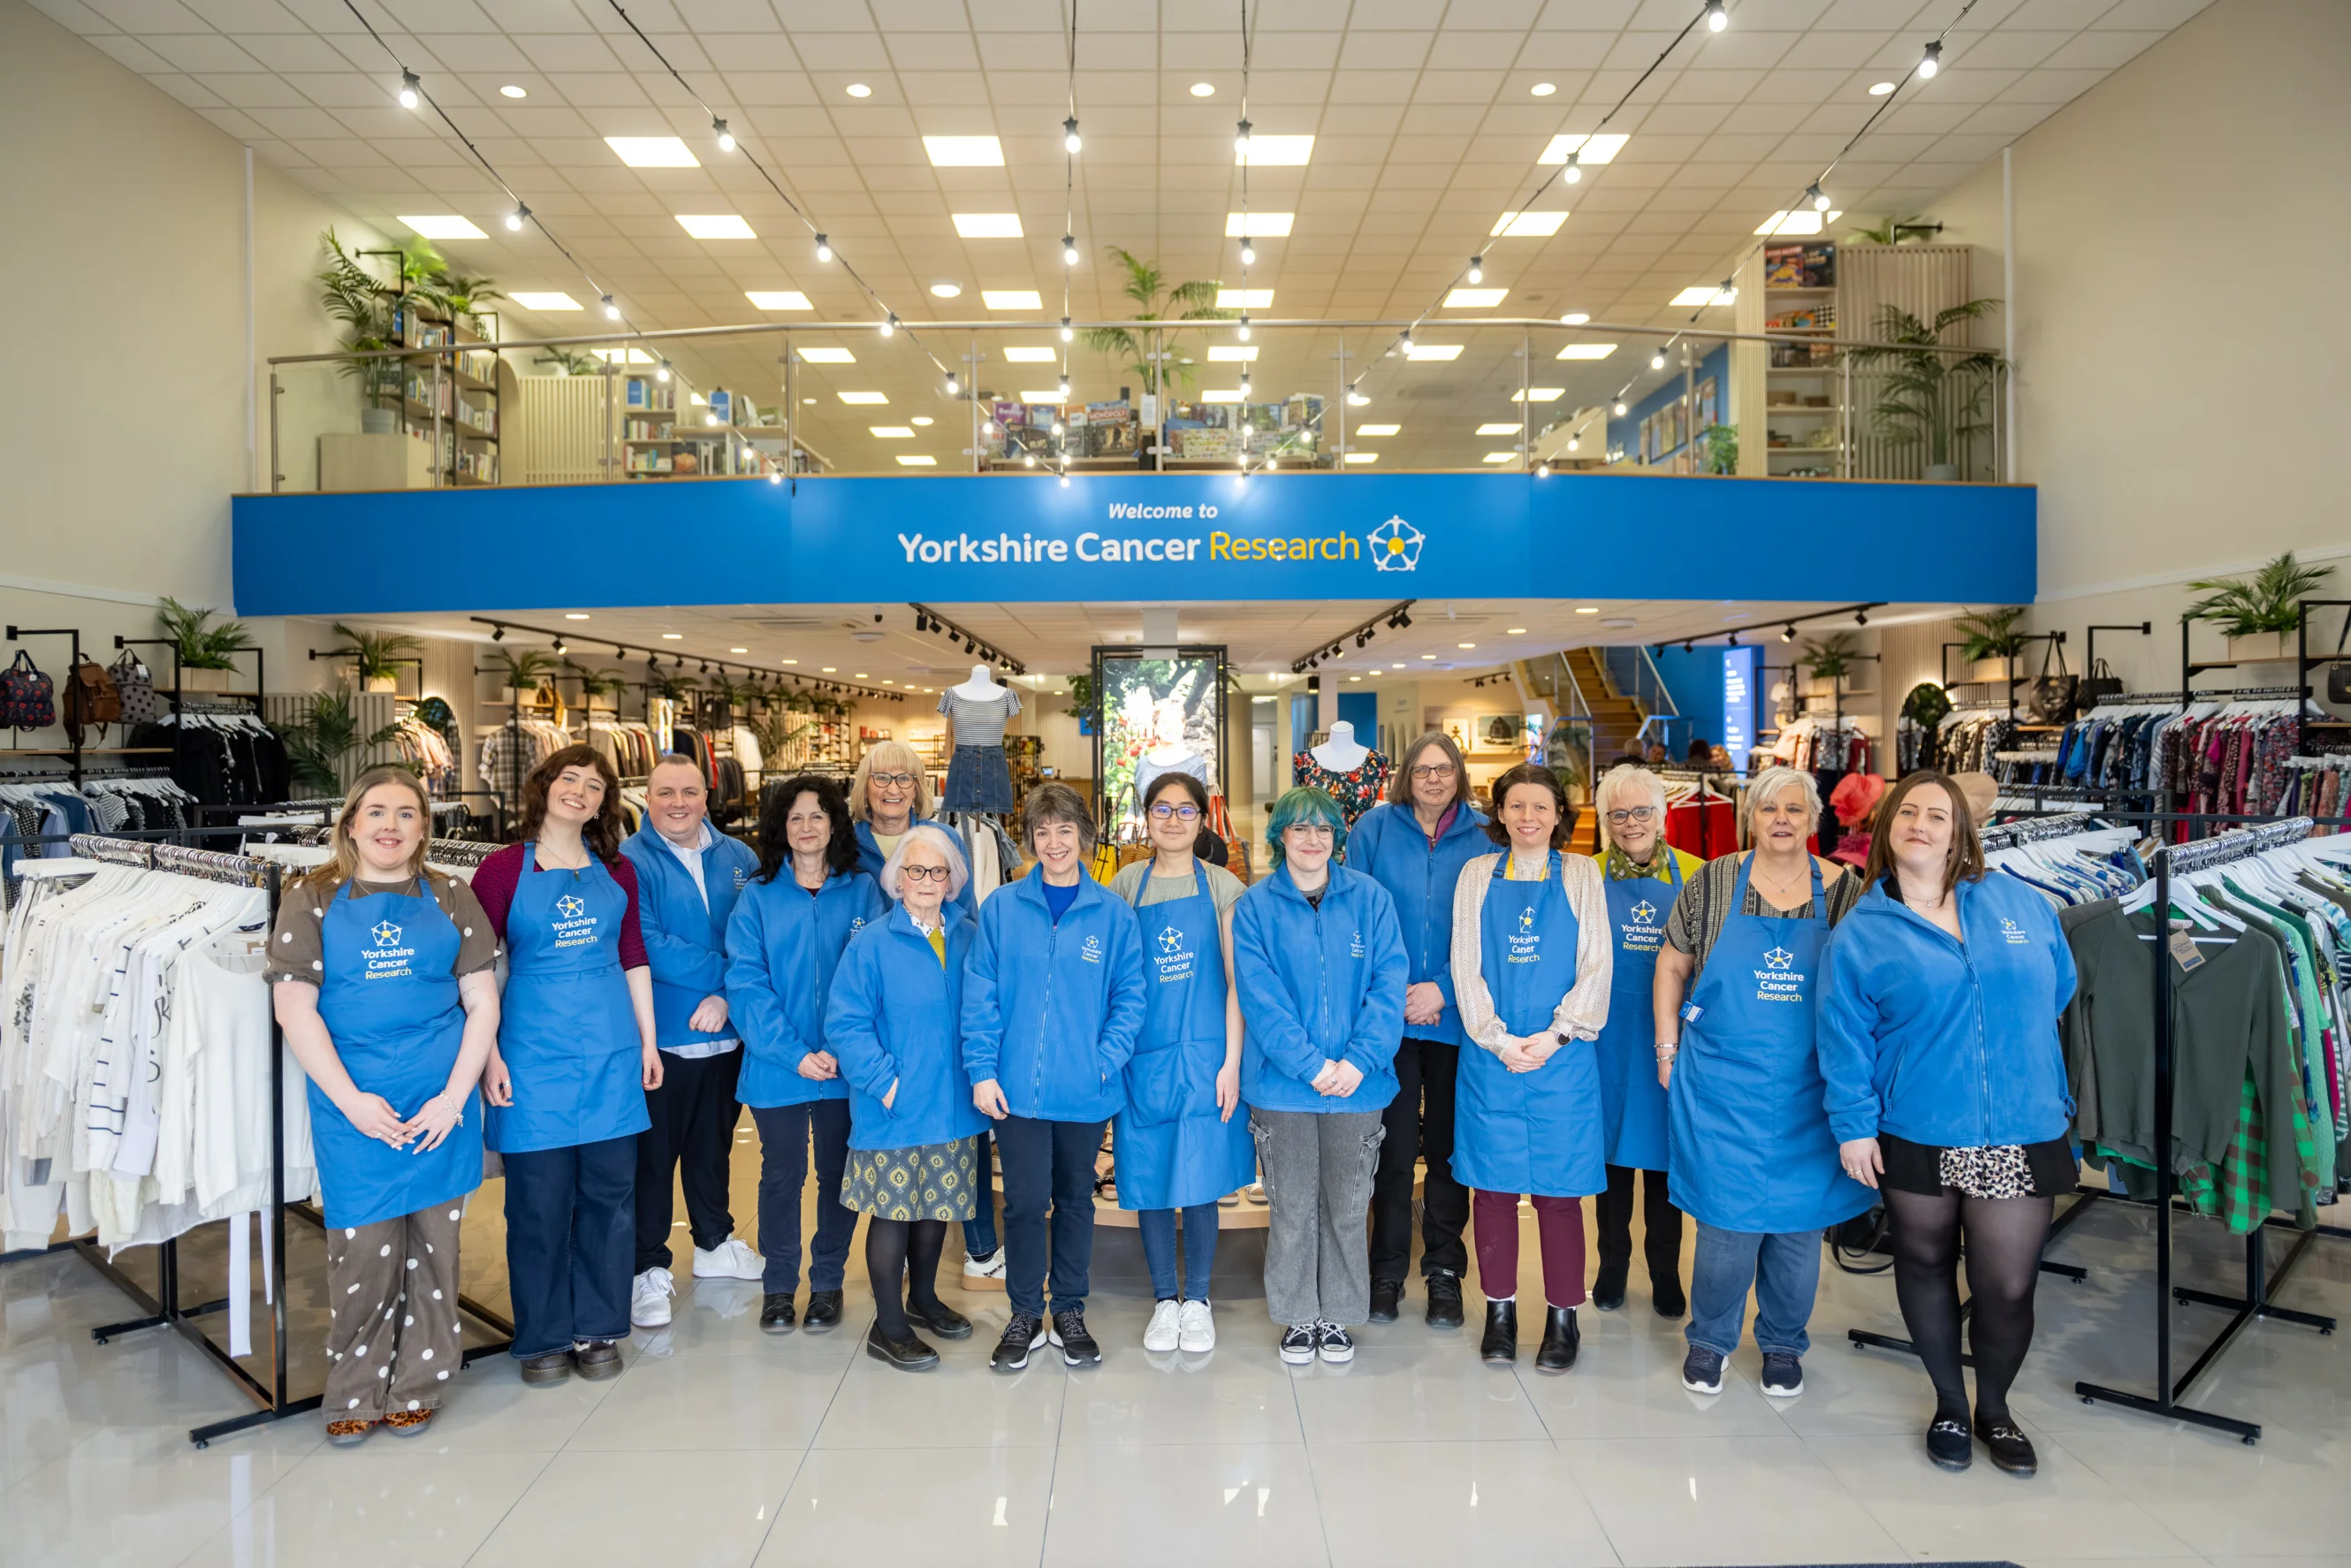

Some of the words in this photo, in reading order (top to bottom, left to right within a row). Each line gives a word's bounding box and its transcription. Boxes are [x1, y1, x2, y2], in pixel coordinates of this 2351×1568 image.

[1108, 503, 1192, 519] Welcome
[1198, 503, 1219, 519] to
[897, 532, 1068, 563] Yorkshire
[1075, 532, 1201, 561] Cancer
[1209, 530, 1360, 560] Research
[552, 917, 597, 931] Yorkshire
[558, 927, 592, 939] Cancer
[1625, 933, 1658, 943] Cancer
[555, 935, 597, 948] Research
[1623, 941, 1662, 952] Research
[361, 948, 415, 959] Yorkshire
[1153, 951, 1194, 965] Yorkshire
[368, 958, 408, 970] Cancer
[1160, 962, 1191, 973] Cancer
[365, 967, 412, 980] Research
[1160, 970, 1194, 984] Research
[1754, 970, 1805, 981] Yorkshire
[1760, 980, 1798, 992] Cancer
[1757, 990, 1802, 1002] Research
